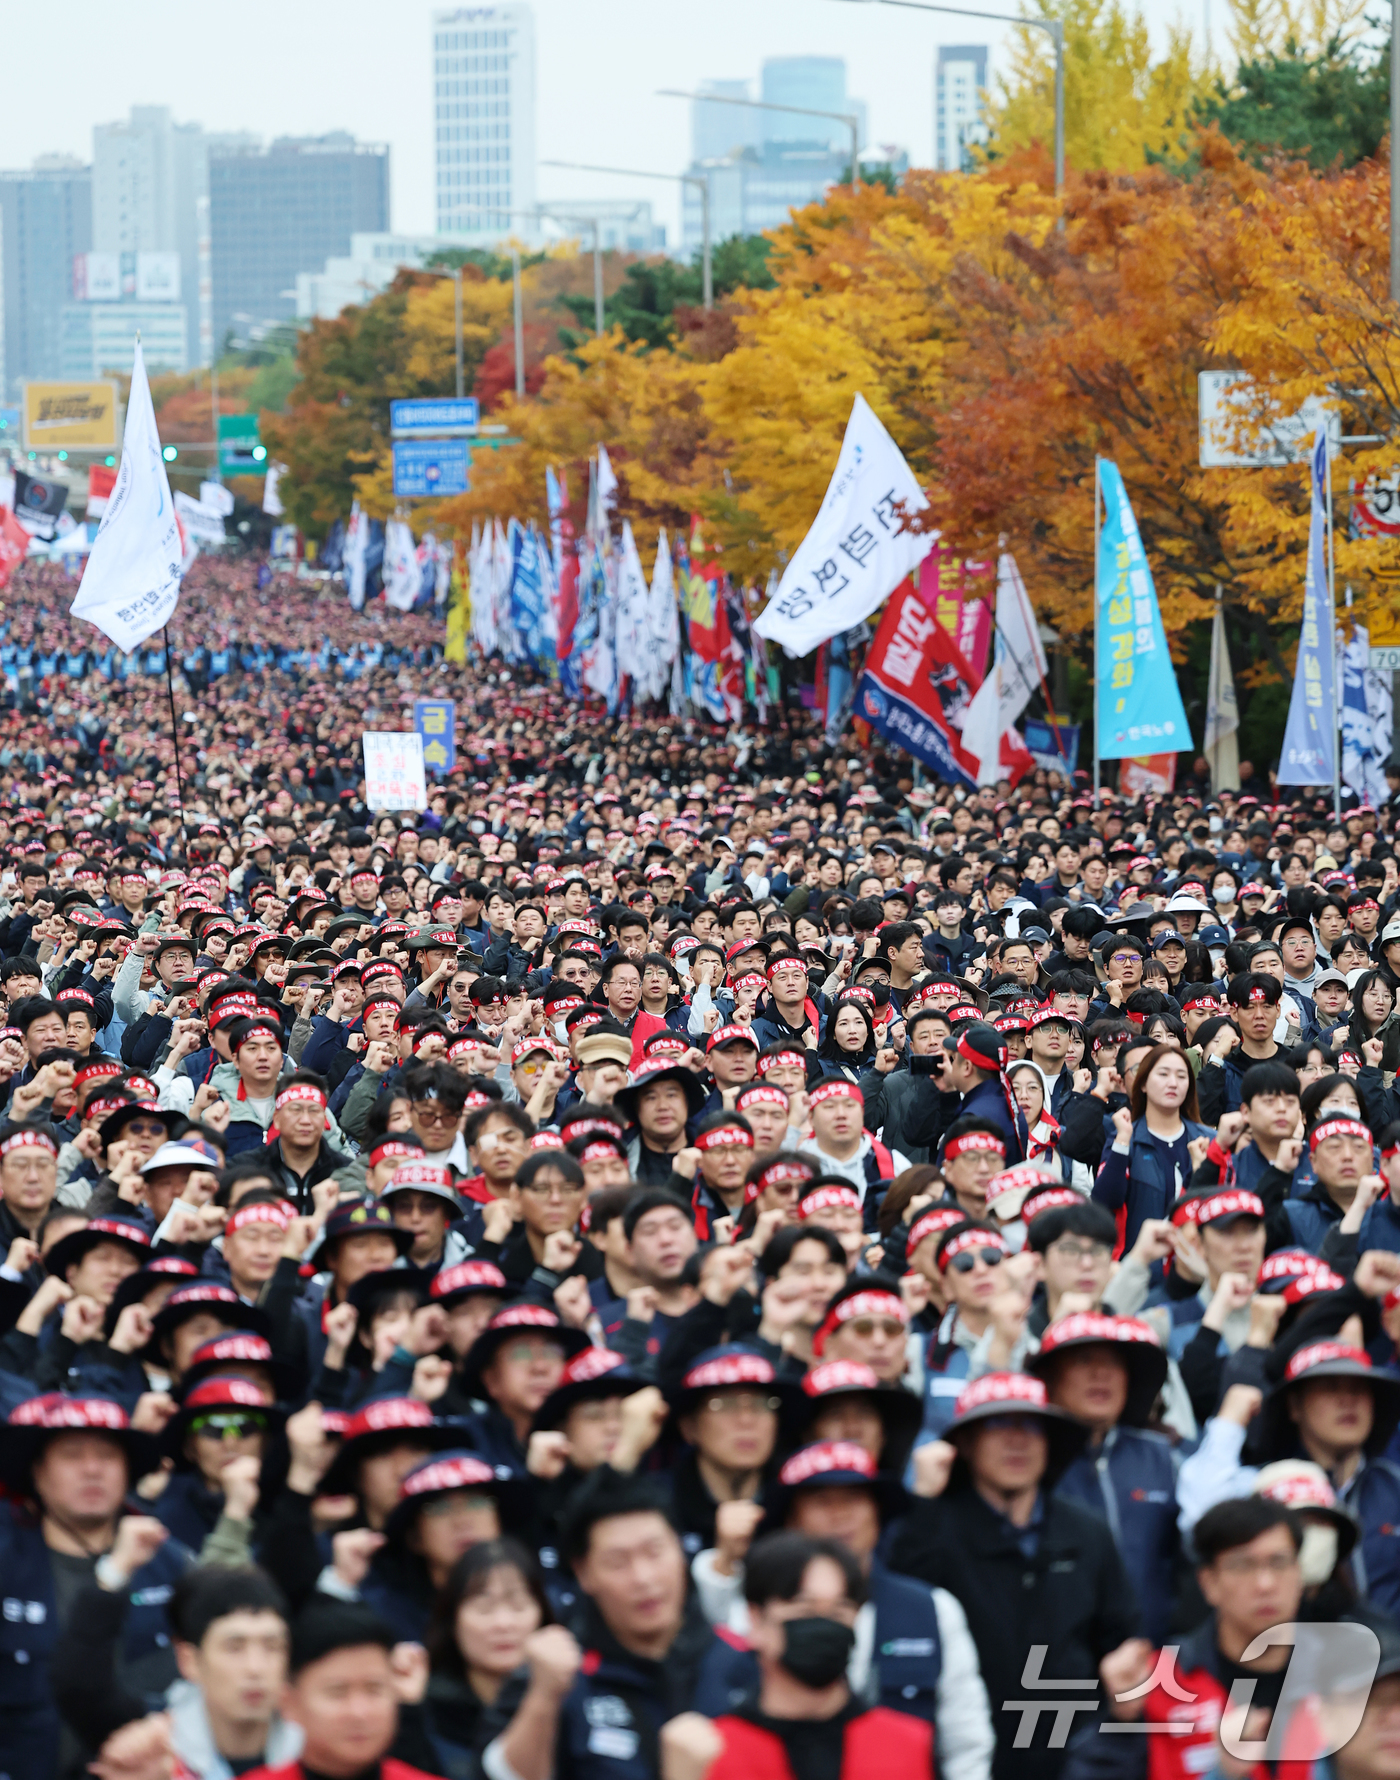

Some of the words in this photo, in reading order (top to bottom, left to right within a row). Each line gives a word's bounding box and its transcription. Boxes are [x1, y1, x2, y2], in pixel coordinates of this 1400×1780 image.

[1376, 651, 1400, 667] 70
[772, 961, 786, 972] 단결
[60, 991, 74, 1000] 단결
[927, 985, 940, 995] 단결
[1195, 998, 1210, 1007] 단결
[1031, 1010, 1049, 1023] 단결
[714, 1028, 731, 1042] 단결
[514, 1041, 531, 1055] 단결
